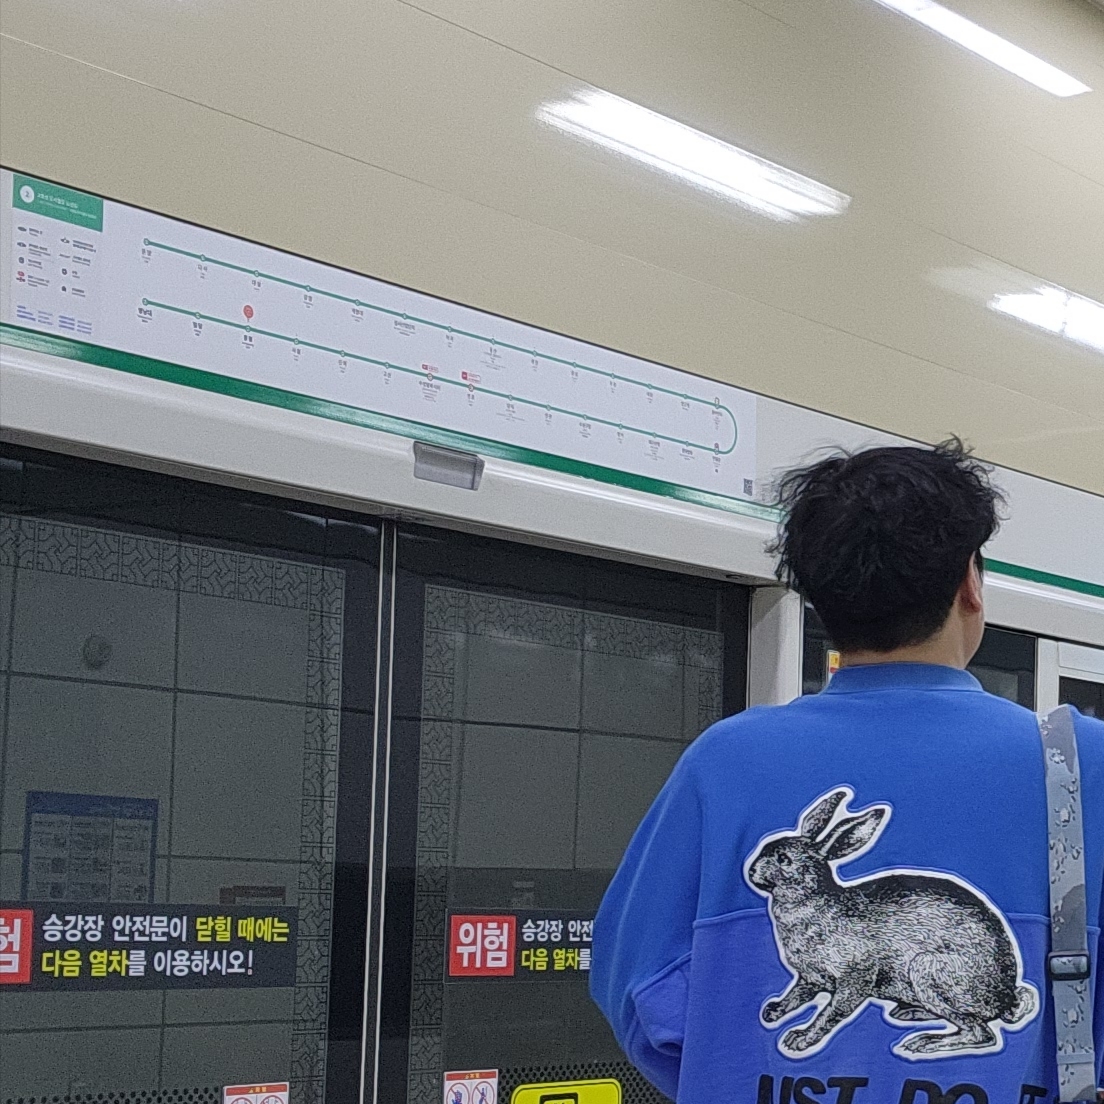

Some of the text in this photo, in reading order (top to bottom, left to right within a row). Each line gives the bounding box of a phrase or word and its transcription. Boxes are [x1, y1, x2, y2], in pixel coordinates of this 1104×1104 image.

[42, 914, 290, 942] 승강장 안전문이 닫힐 때에는
[521, 919, 563, 941] 승강장
[456, 922, 509, 969] 위험
[41, 949, 254, 977] 다음 열차를 이용하시오!
[521, 949, 548, 971] 다음
